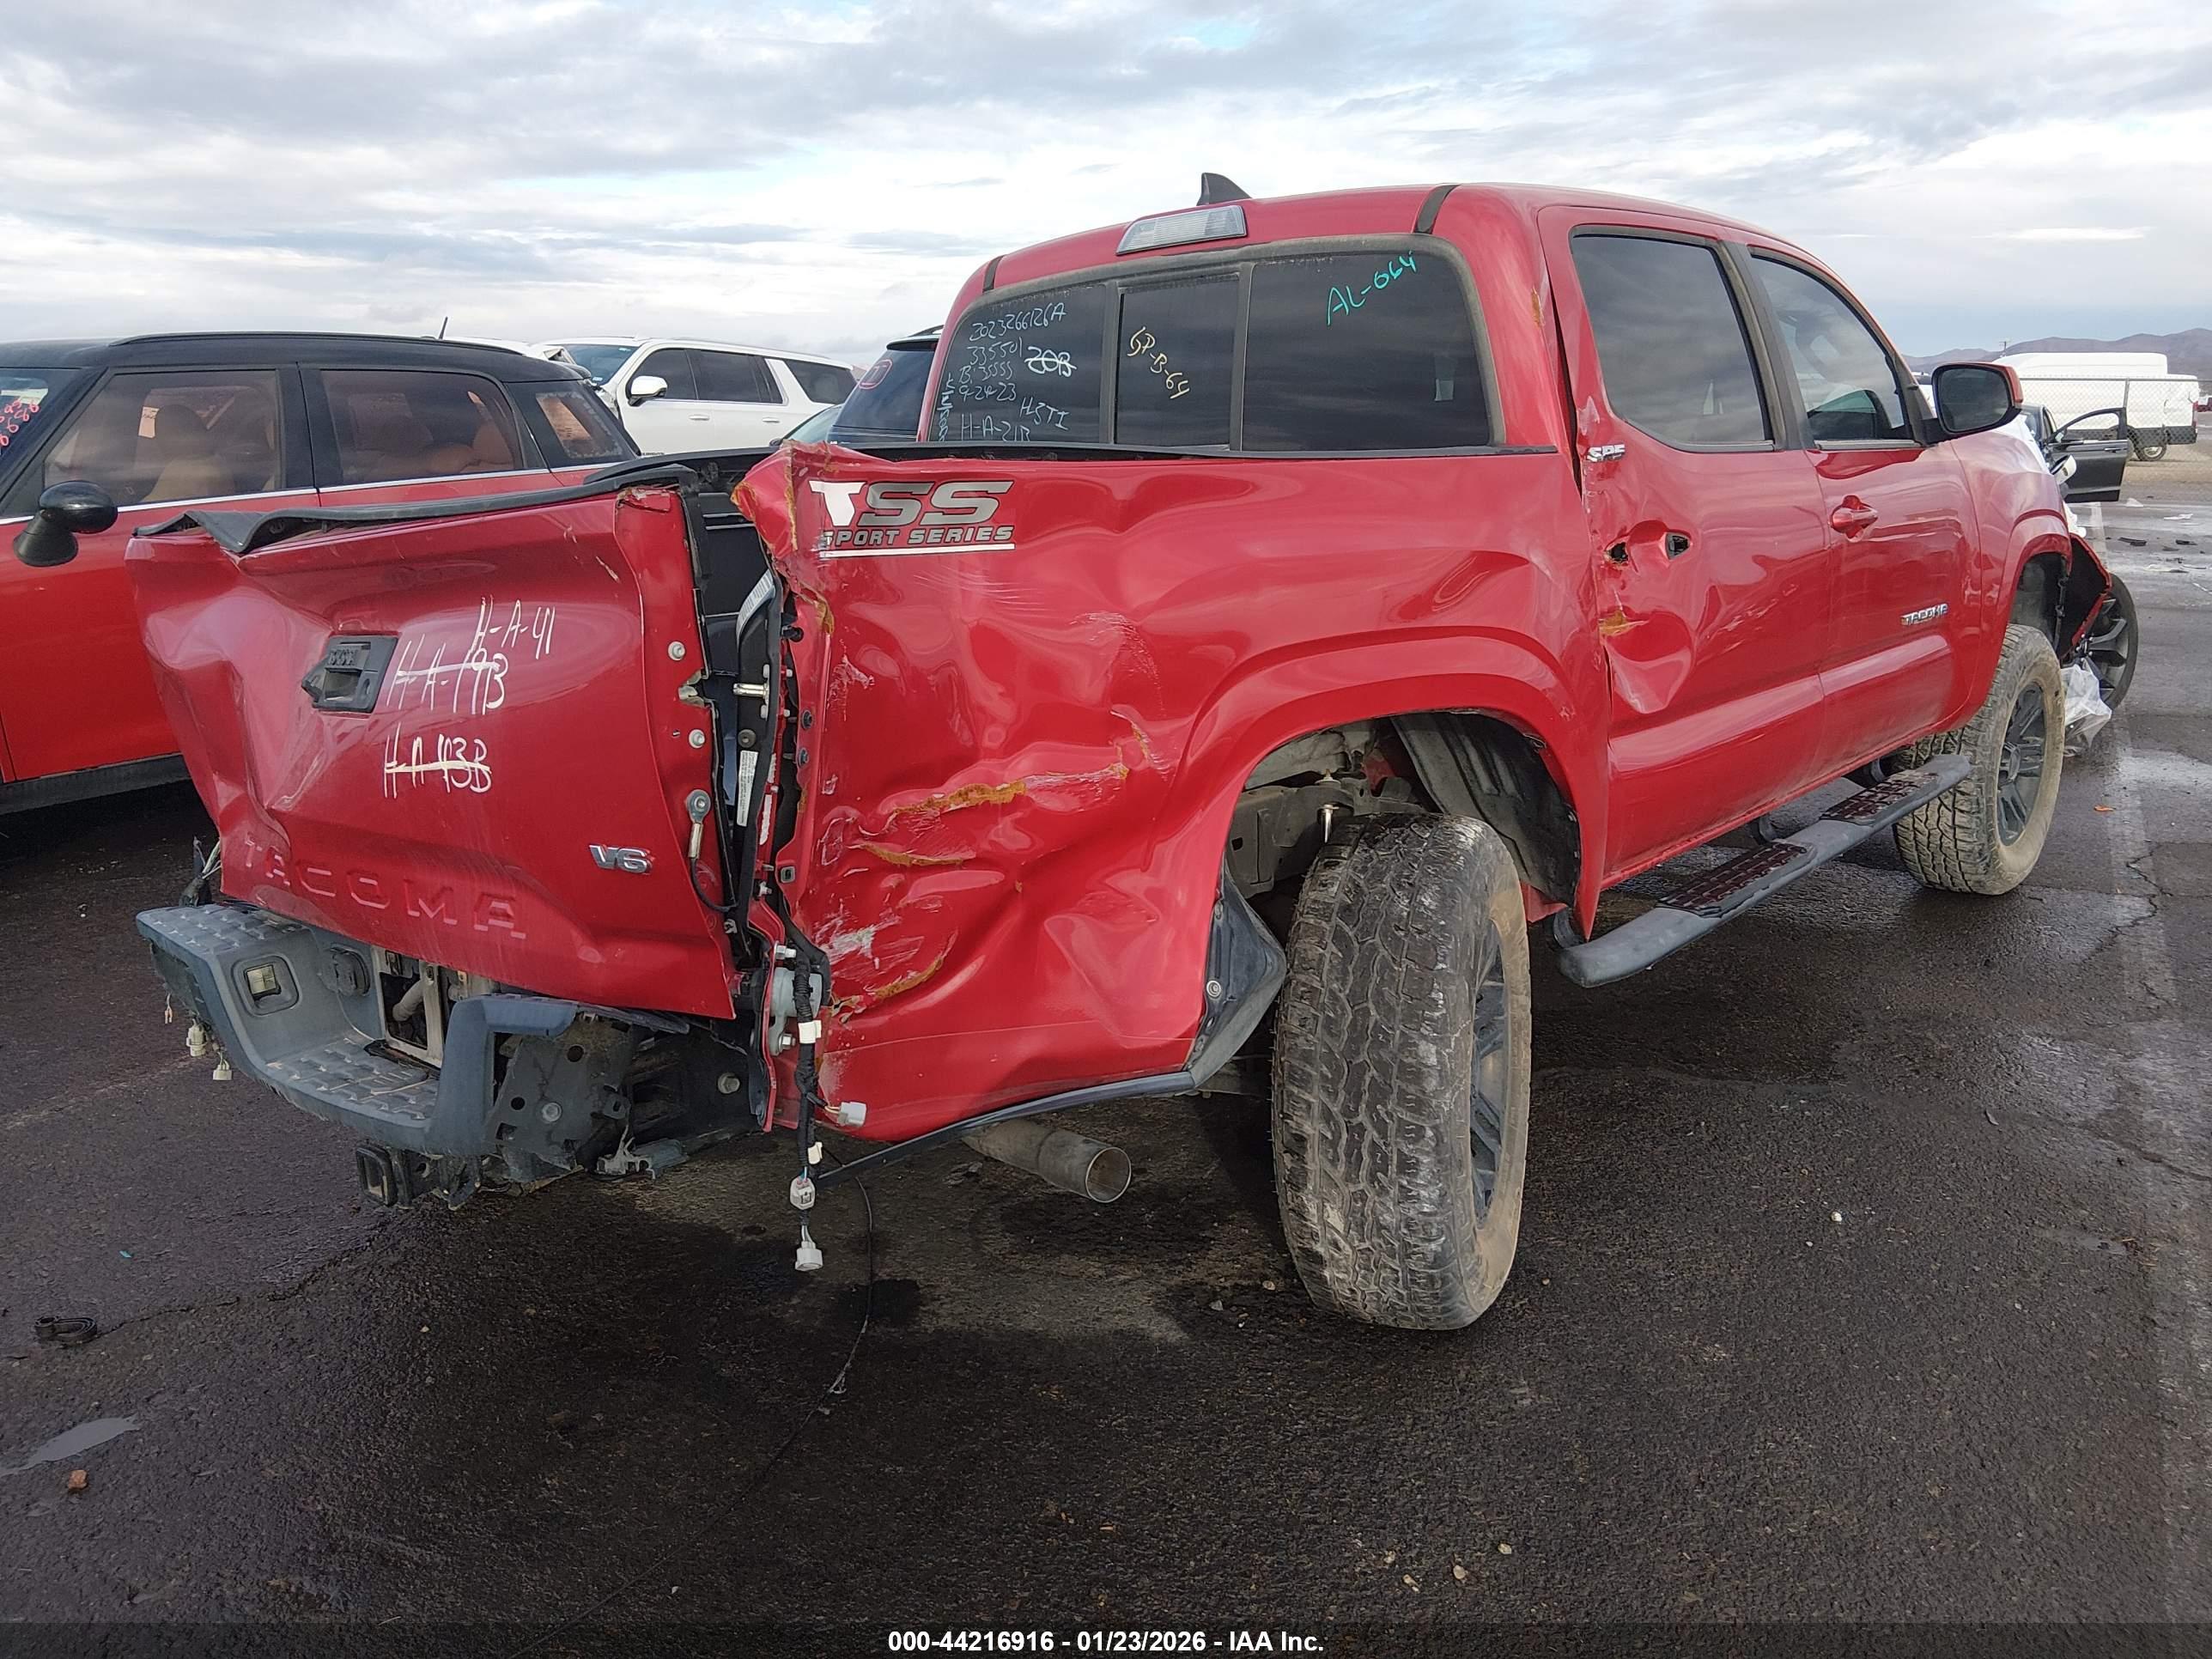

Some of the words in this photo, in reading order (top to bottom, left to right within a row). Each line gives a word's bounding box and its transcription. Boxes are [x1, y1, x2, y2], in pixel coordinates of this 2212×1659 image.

[809, 480, 1014, 526] TSS
[820, 529, 900, 547] SPORT
[908, 526, 1015, 545] SERIES
[589, 845, 652, 873] V6
